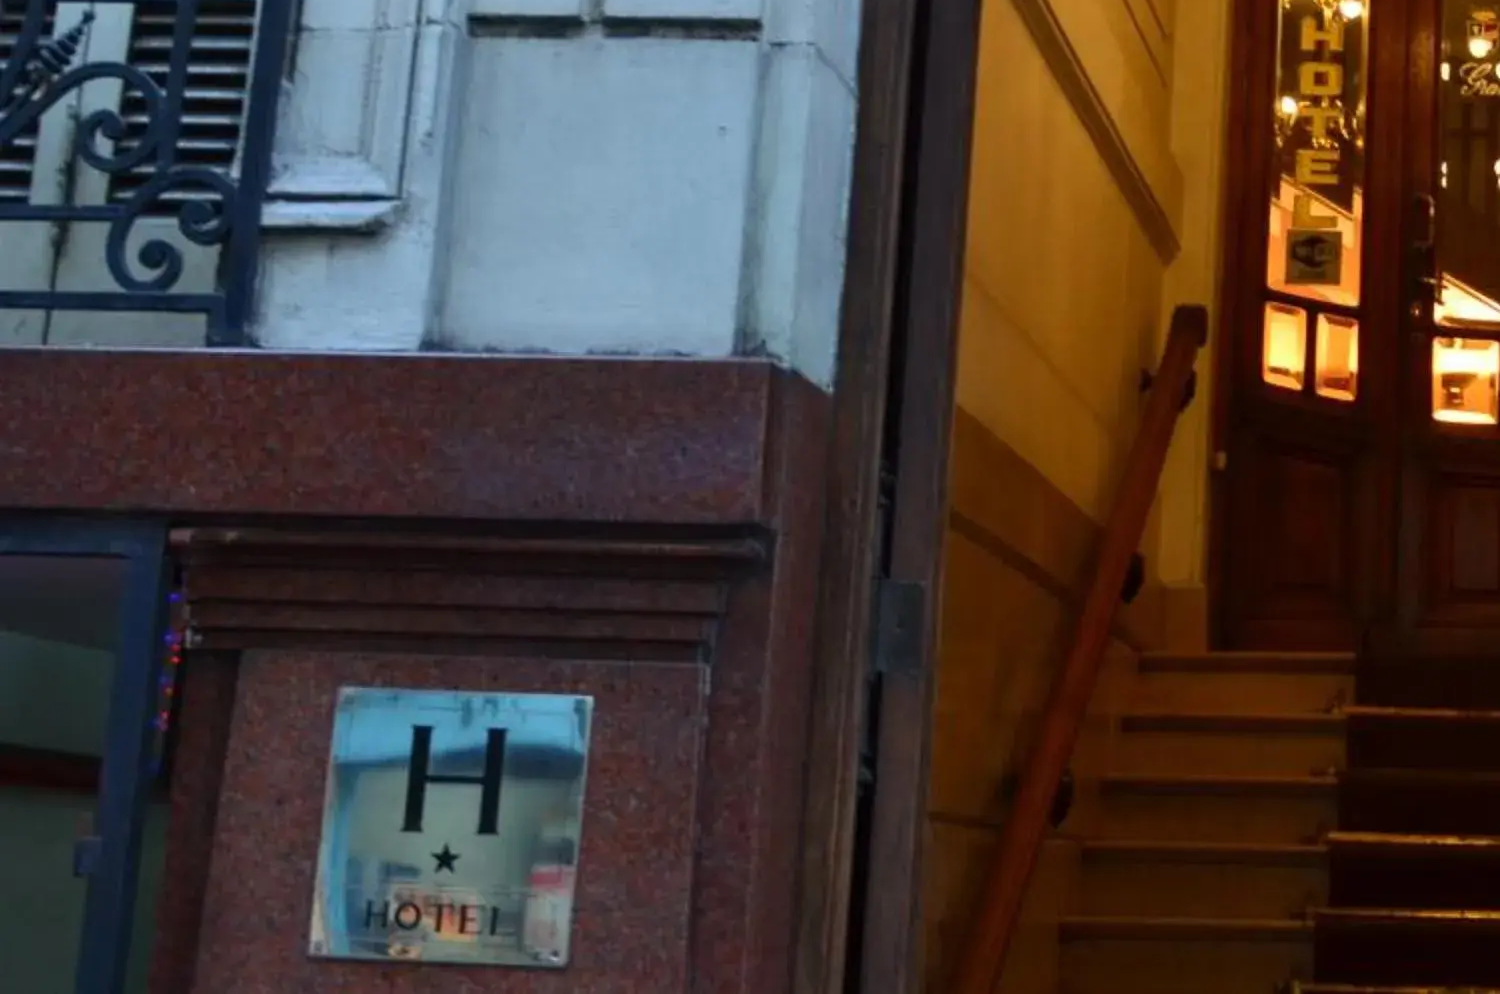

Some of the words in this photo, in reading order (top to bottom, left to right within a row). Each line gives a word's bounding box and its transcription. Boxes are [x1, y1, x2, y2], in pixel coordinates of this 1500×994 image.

[1292, 16, 1344, 229] HOTEL
[399, 724, 508, 835] H
[363, 900, 516, 936] HOTEL
